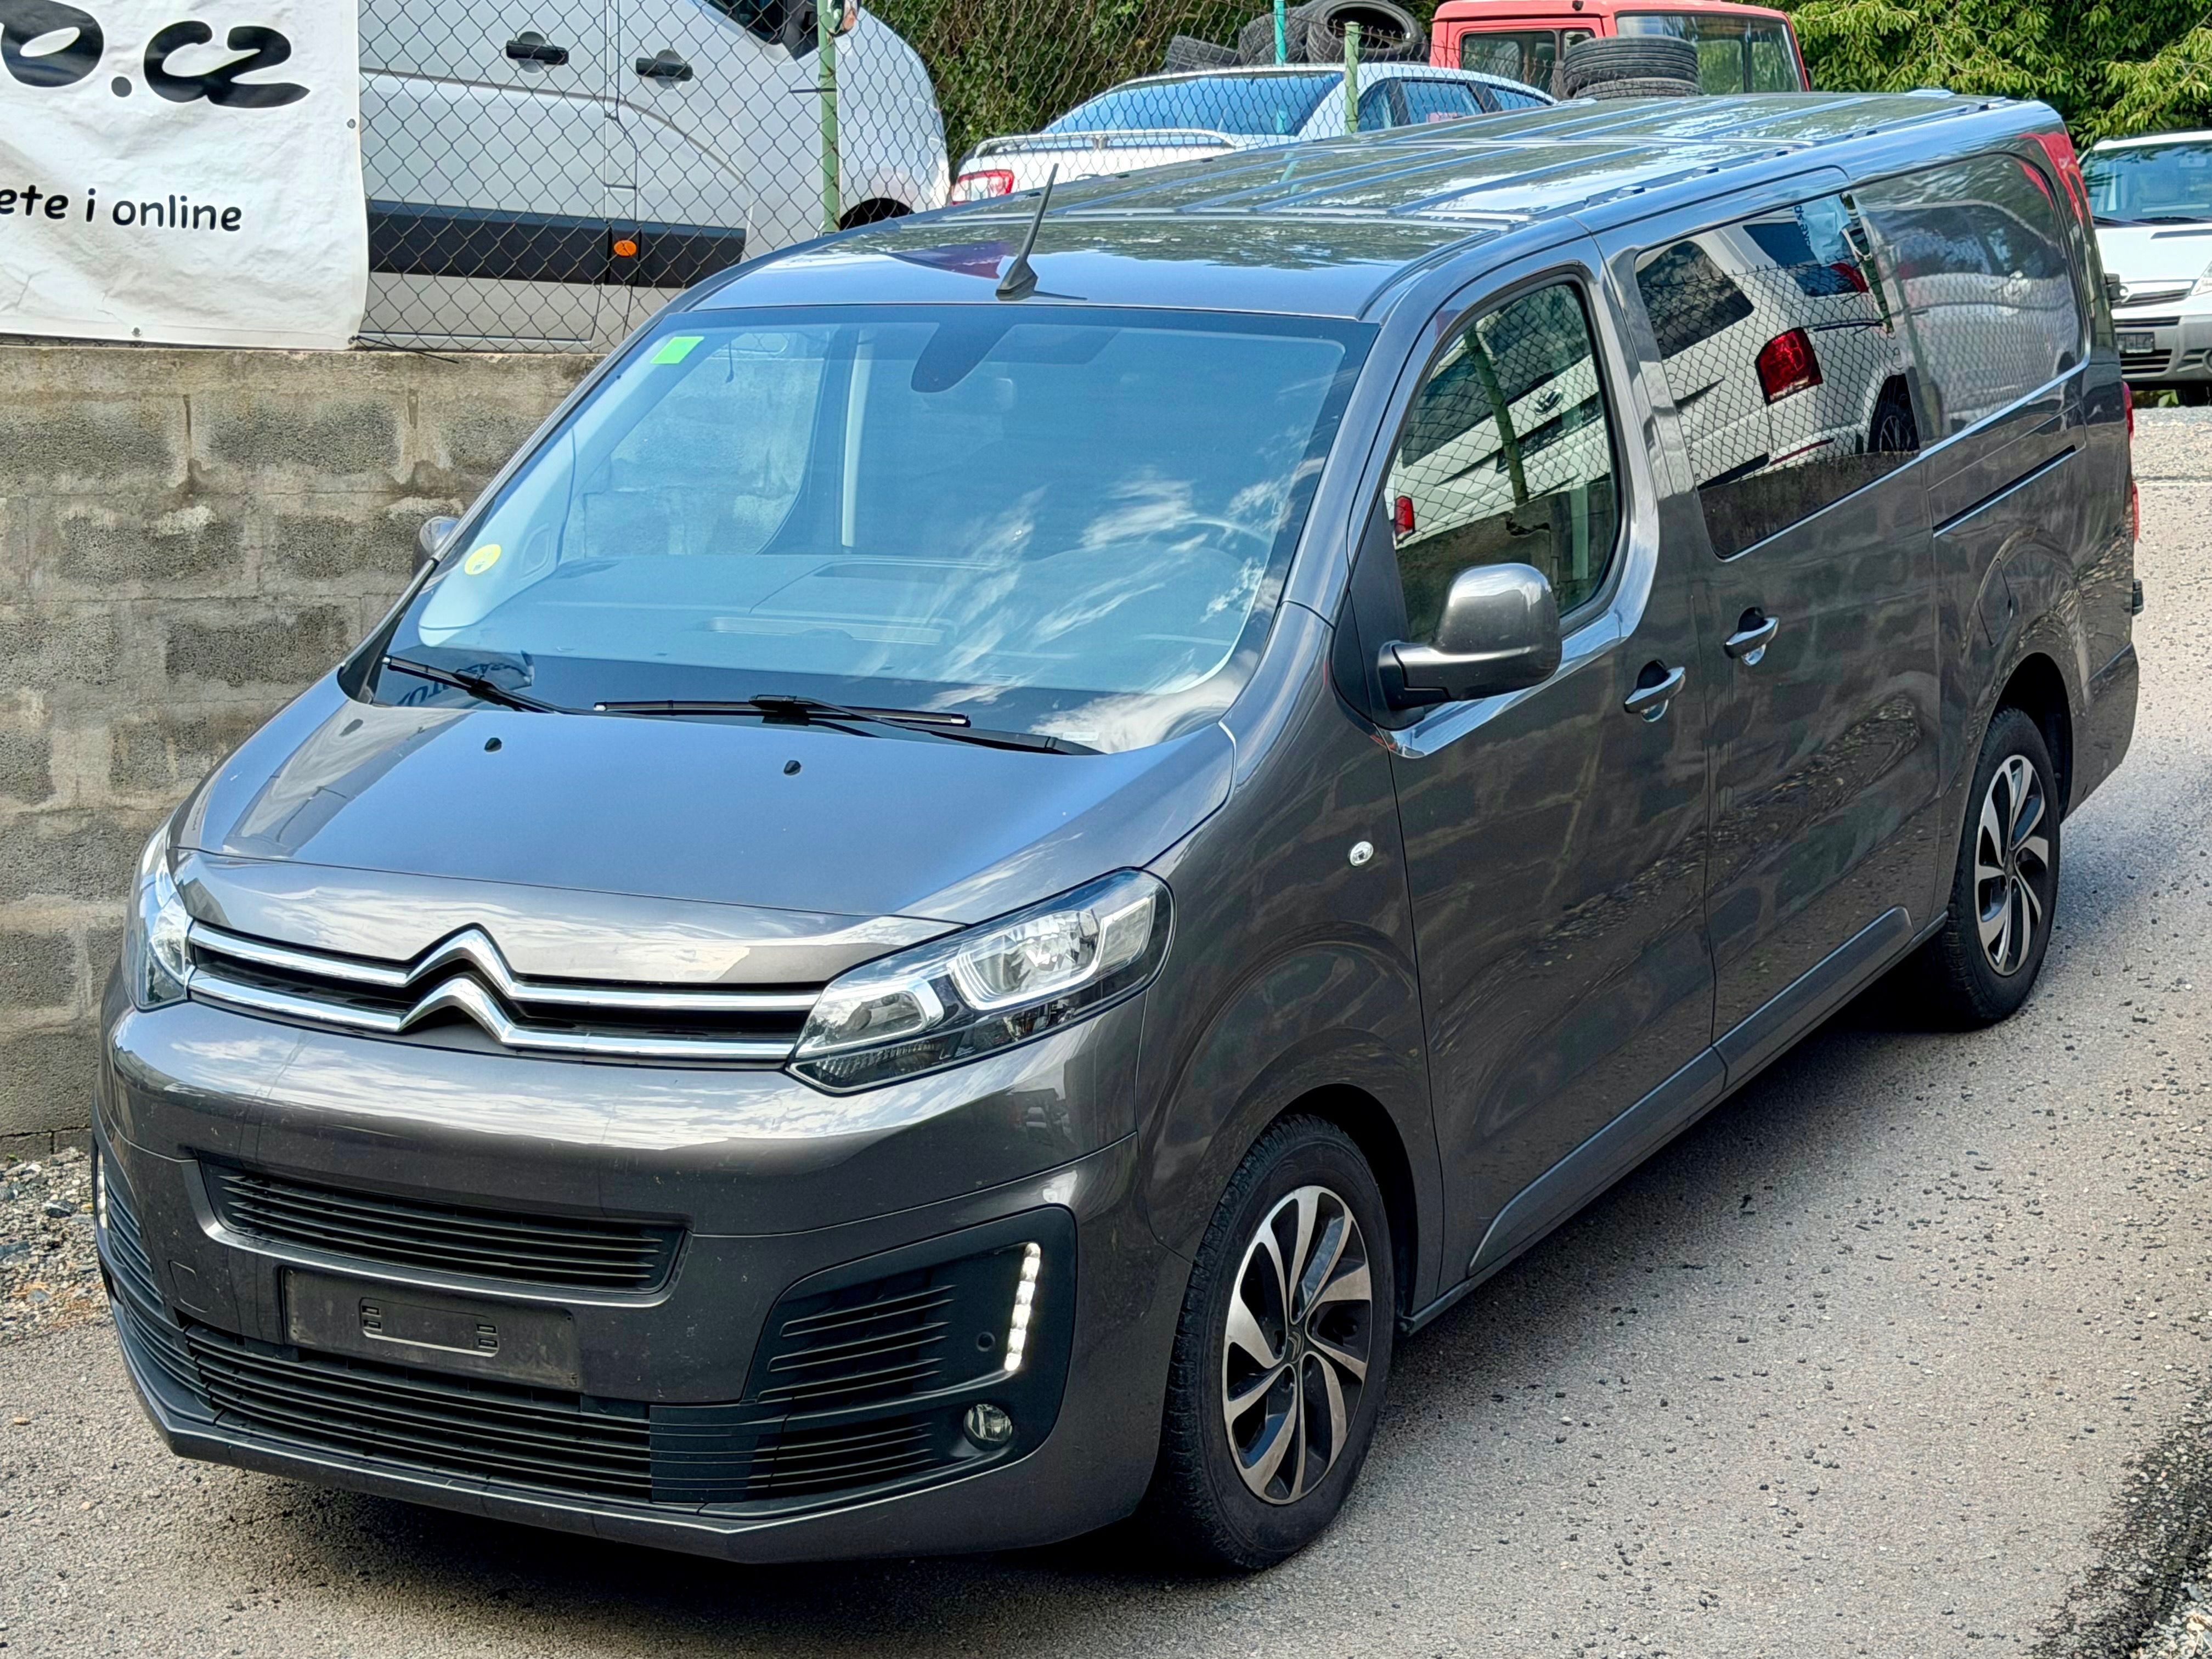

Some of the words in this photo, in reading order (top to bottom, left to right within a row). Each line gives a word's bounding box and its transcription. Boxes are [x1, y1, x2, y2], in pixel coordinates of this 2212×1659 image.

[0, 185, 69, 219] ete
[86, 188, 96, 222] i
[112, 195, 242, 232] online
